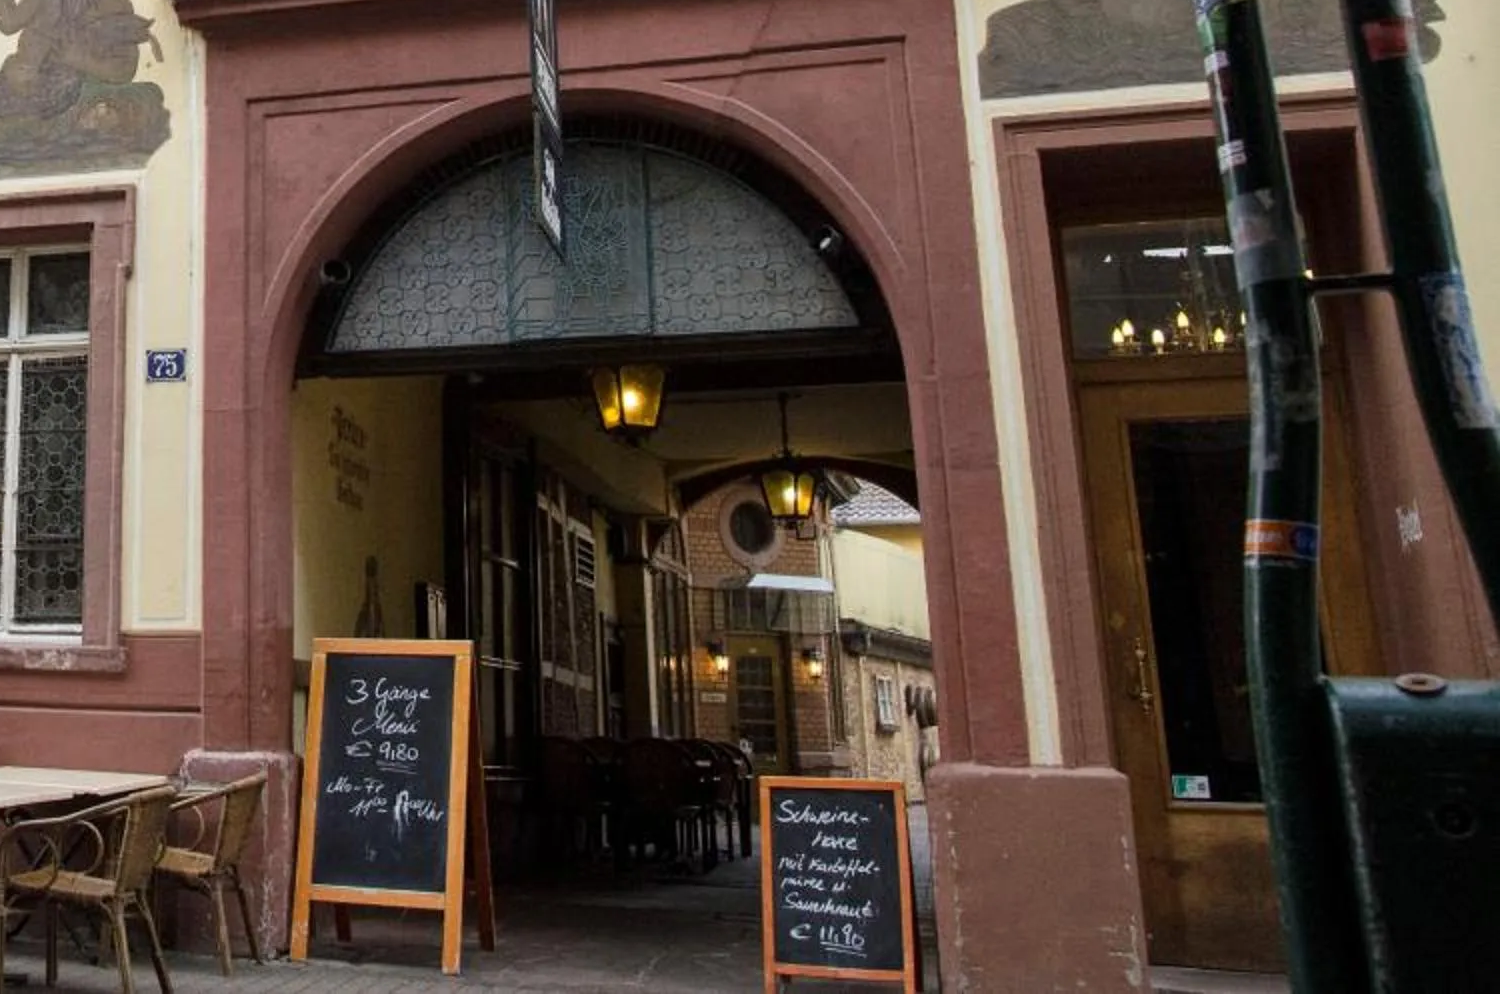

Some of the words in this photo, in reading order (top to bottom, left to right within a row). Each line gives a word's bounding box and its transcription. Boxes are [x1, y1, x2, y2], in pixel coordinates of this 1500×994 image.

[153, 353, 178, 377] 75
[345, 679, 369, 704] 3
[375, 677, 431, 719] Gänge
[351, 711, 419, 735] Menü
[379, 741, 419, 760] 9,80
[779, 853, 805, 871] mit
[782, 891, 874, 918] Sauerkraut
[790, 923, 812, 940] €
